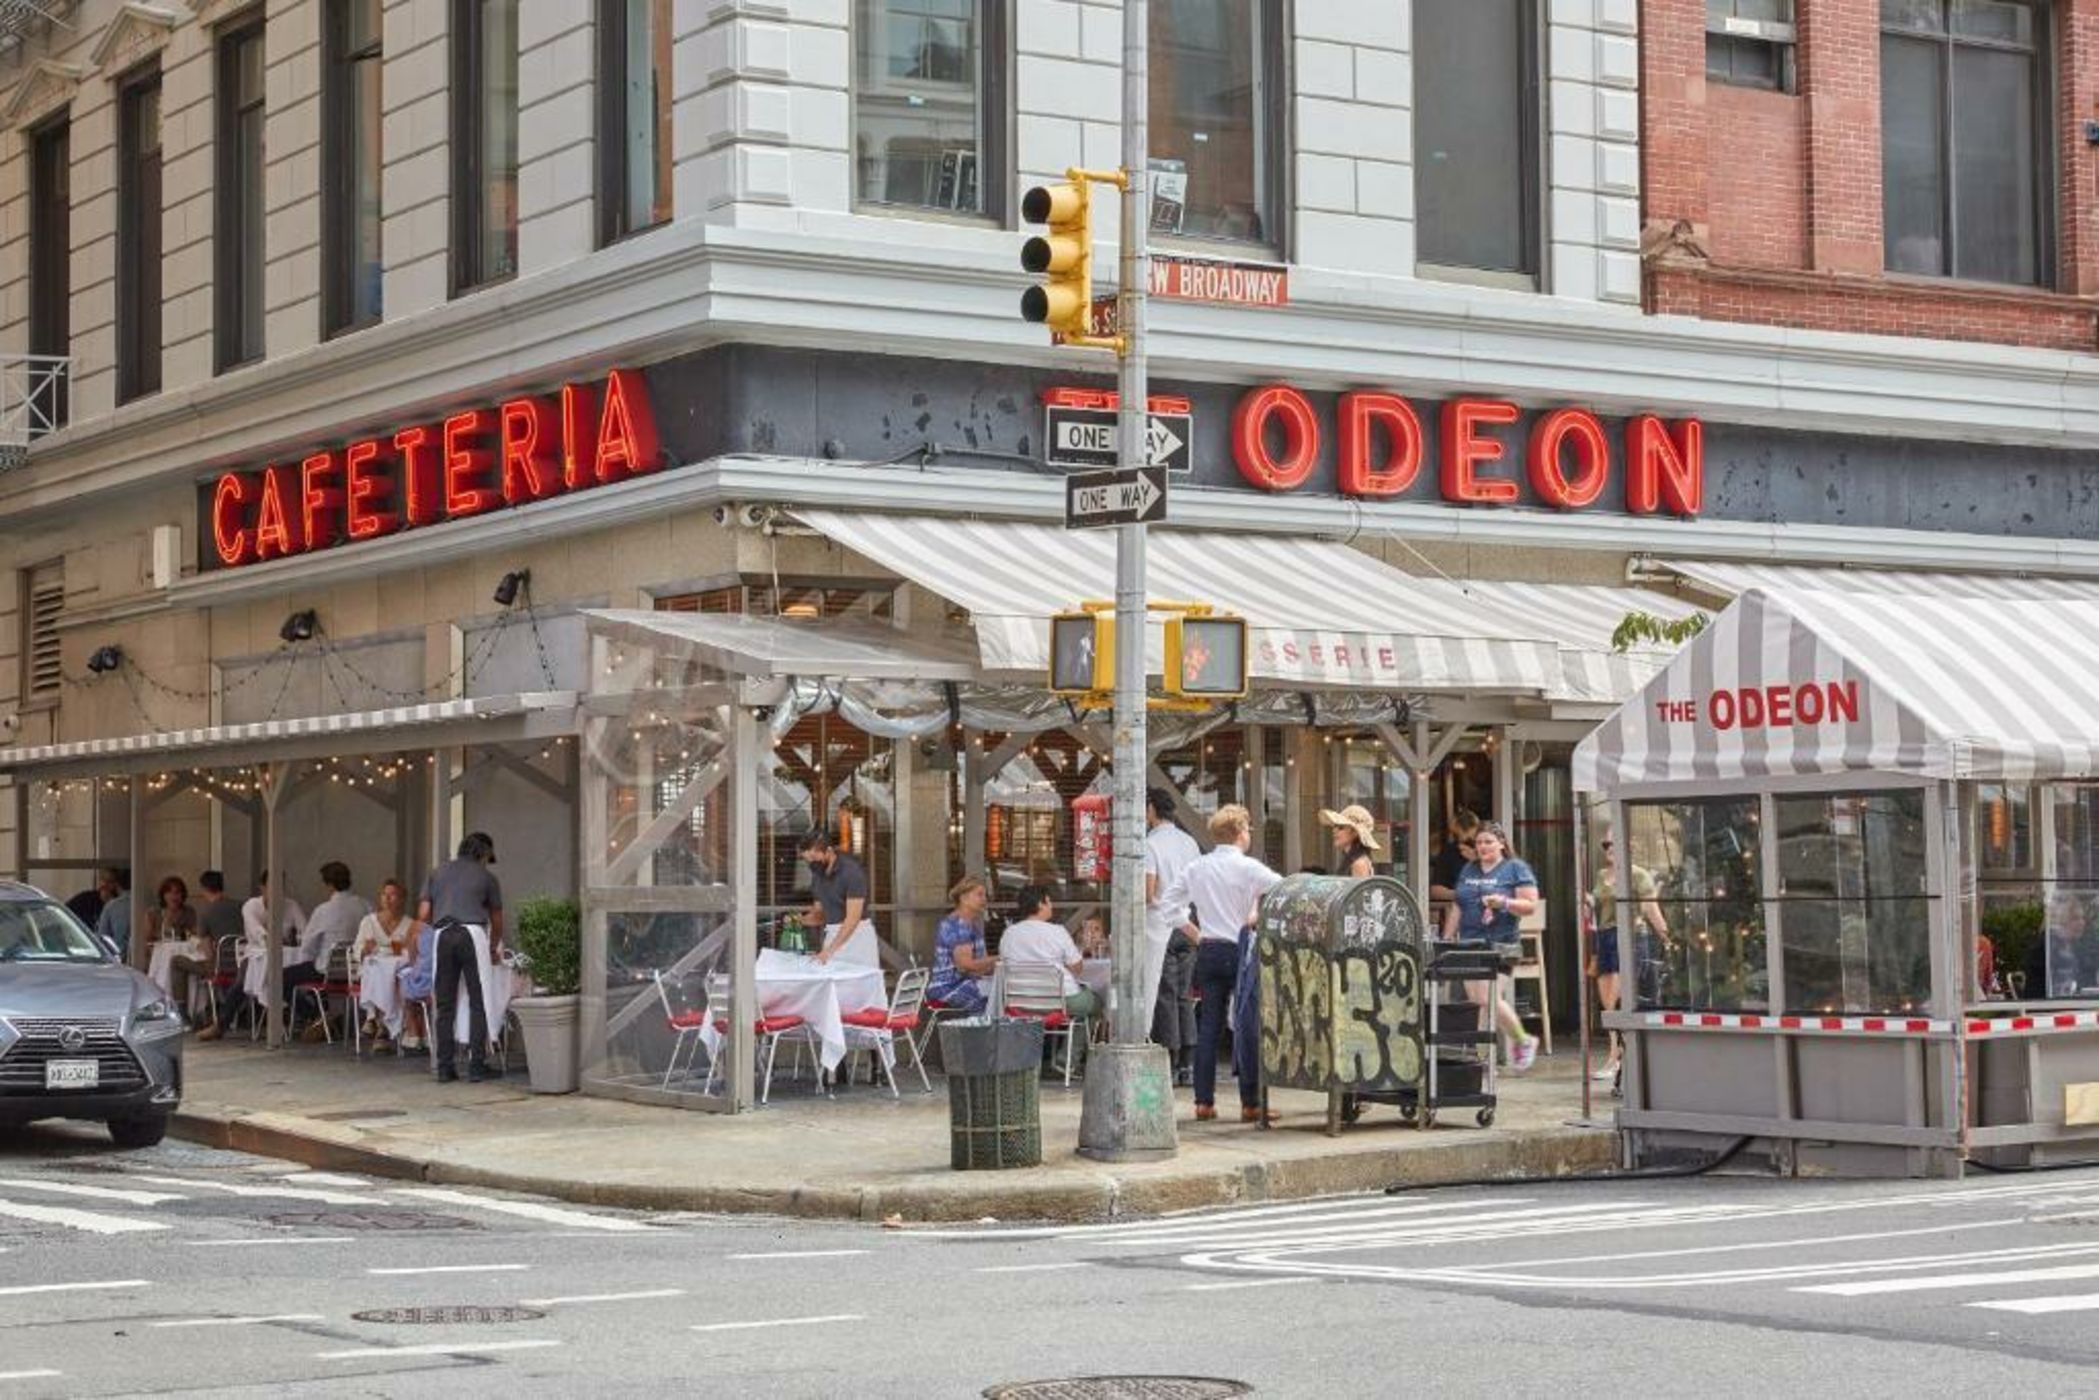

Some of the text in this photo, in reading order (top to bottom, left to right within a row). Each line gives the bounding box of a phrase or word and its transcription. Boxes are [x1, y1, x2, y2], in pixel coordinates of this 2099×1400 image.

[1180, 265, 1281, 303] BROADWAY
[1069, 426, 1169, 453] ONE AY
[1232, 384, 1704, 516] ODEON
[212, 368, 658, 566] CAFETERIA
[1079, 485, 1150, 511] ONE WAY
[1259, 639, 1396, 670] SSERIE
[1656, 679, 1859, 731] THE ODEON
